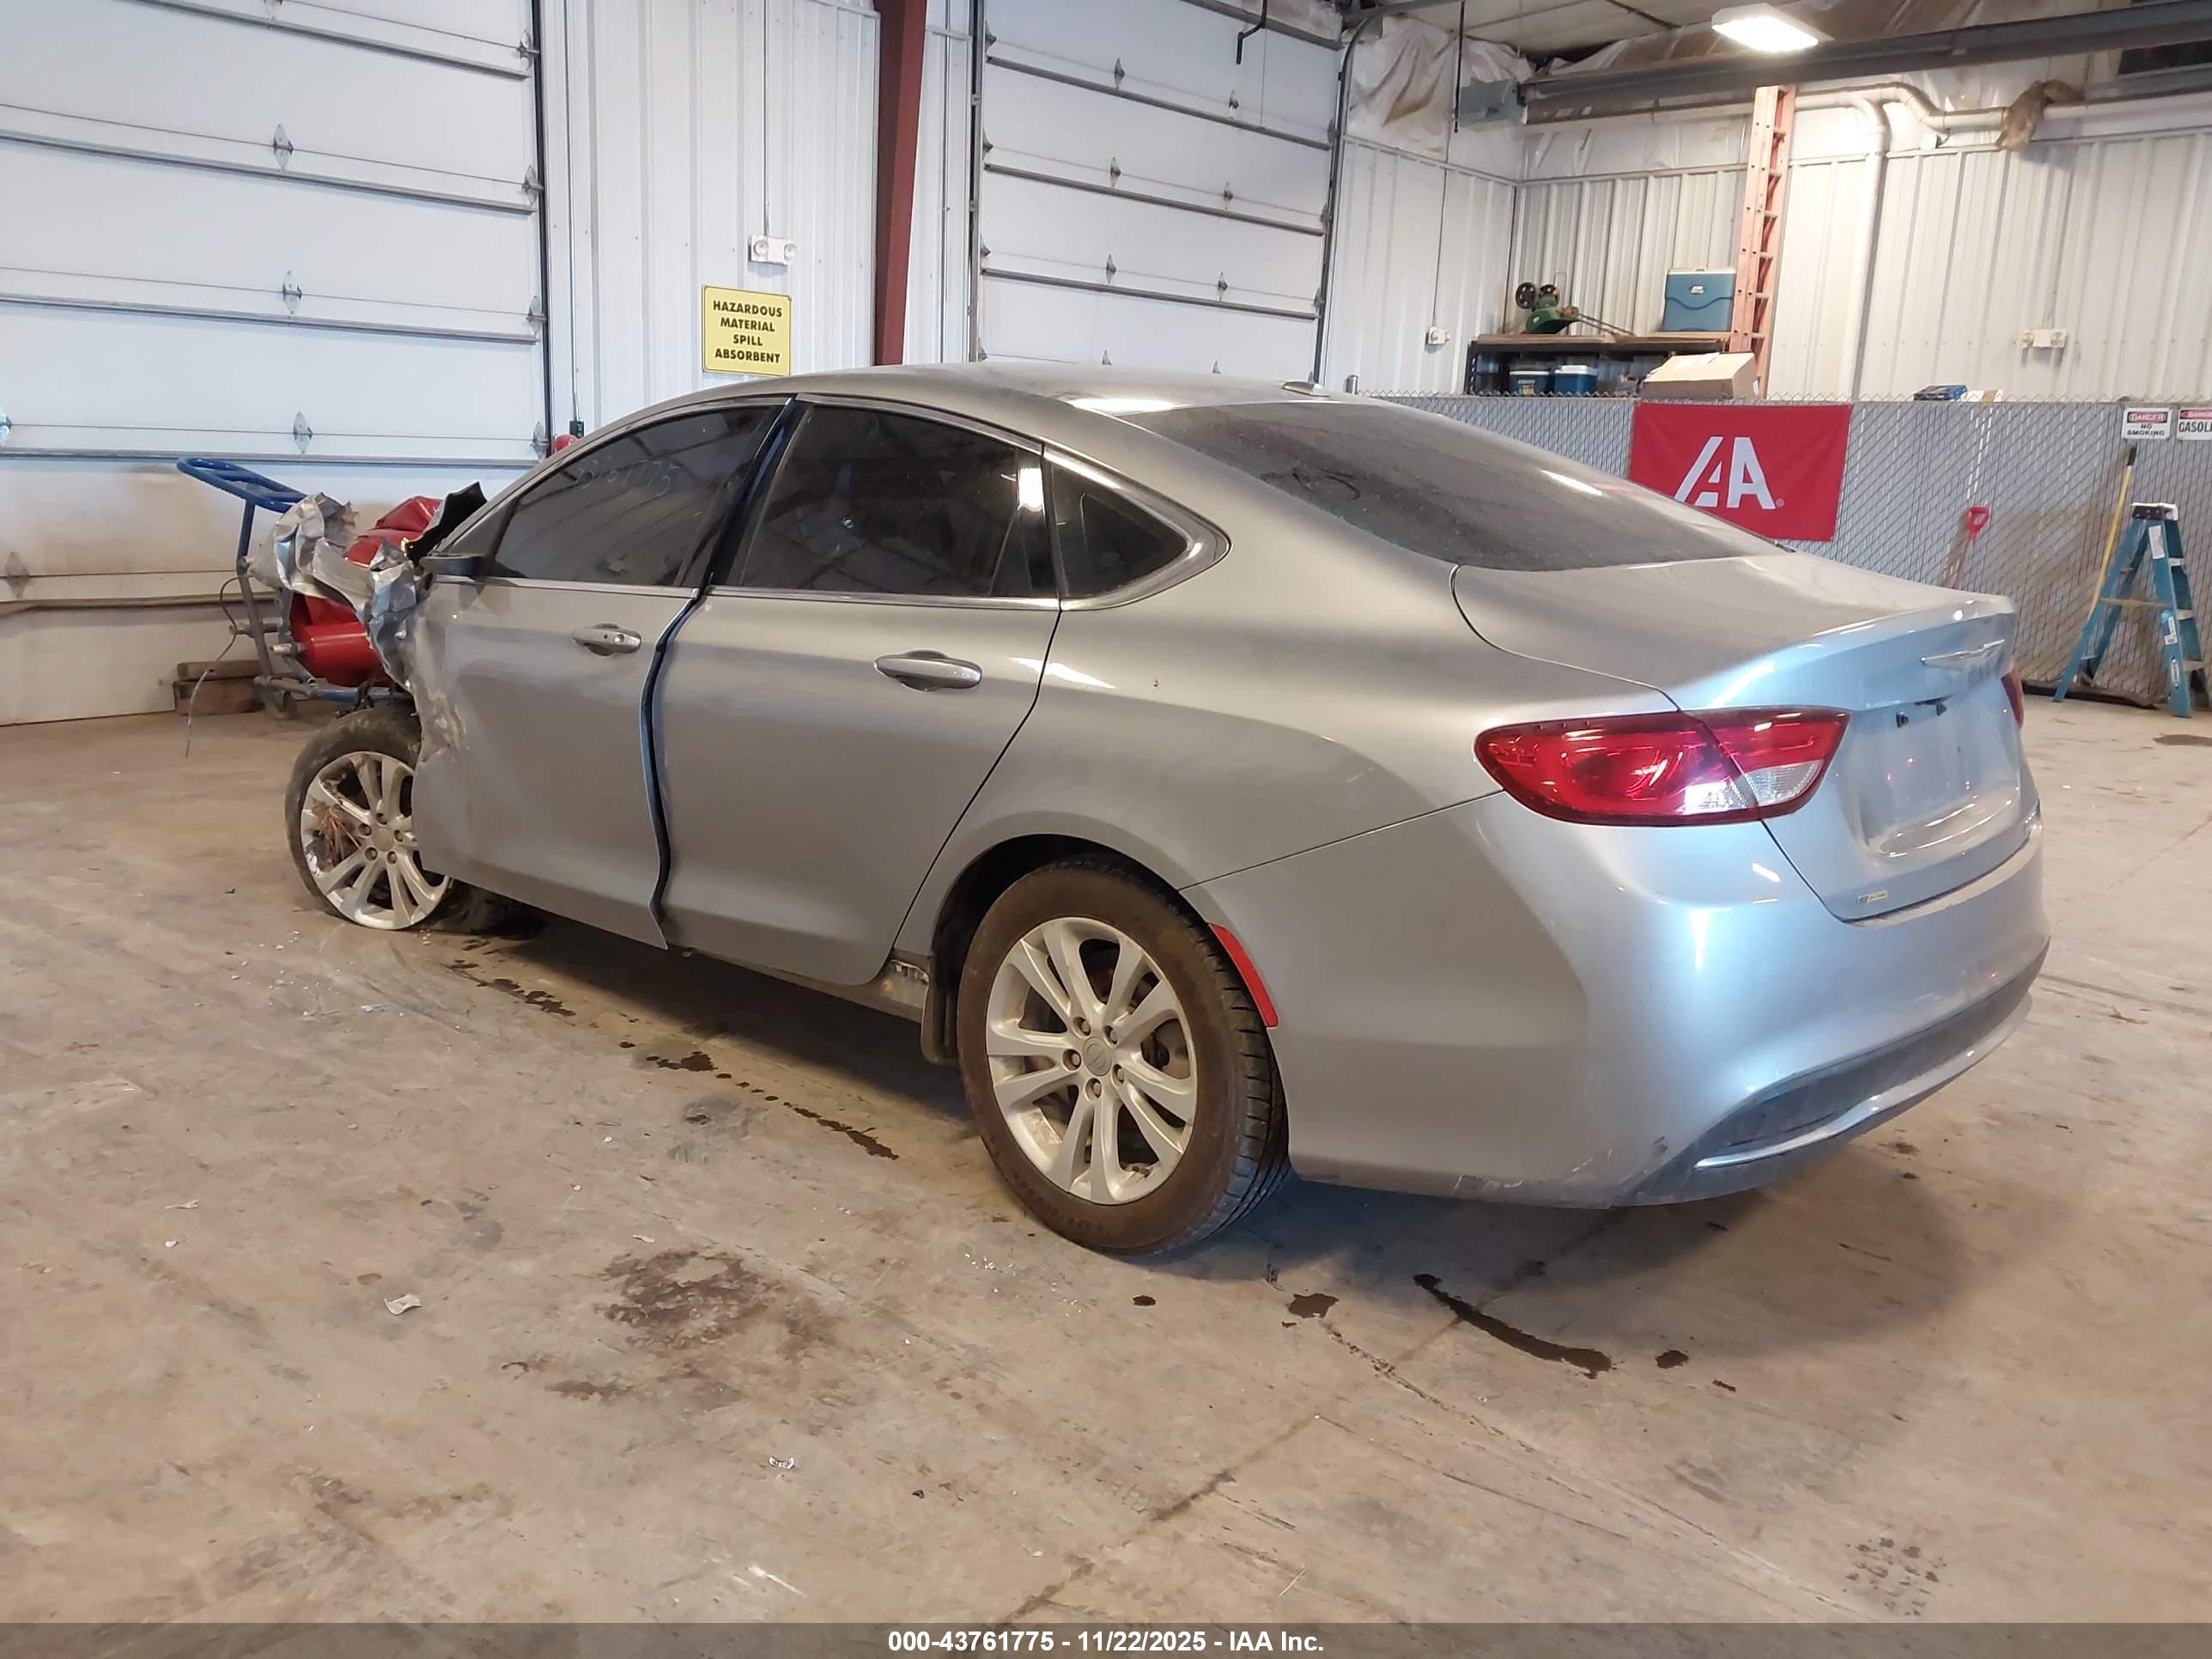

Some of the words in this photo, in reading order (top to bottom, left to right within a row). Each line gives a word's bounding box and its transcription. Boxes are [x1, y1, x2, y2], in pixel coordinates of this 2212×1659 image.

[713, 300, 782, 318] HAZARDOUS
[720, 317, 775, 332] MATERIAL
[732, 334, 763, 346] SPILL
[714, 348, 781, 363] ABSORBENT
